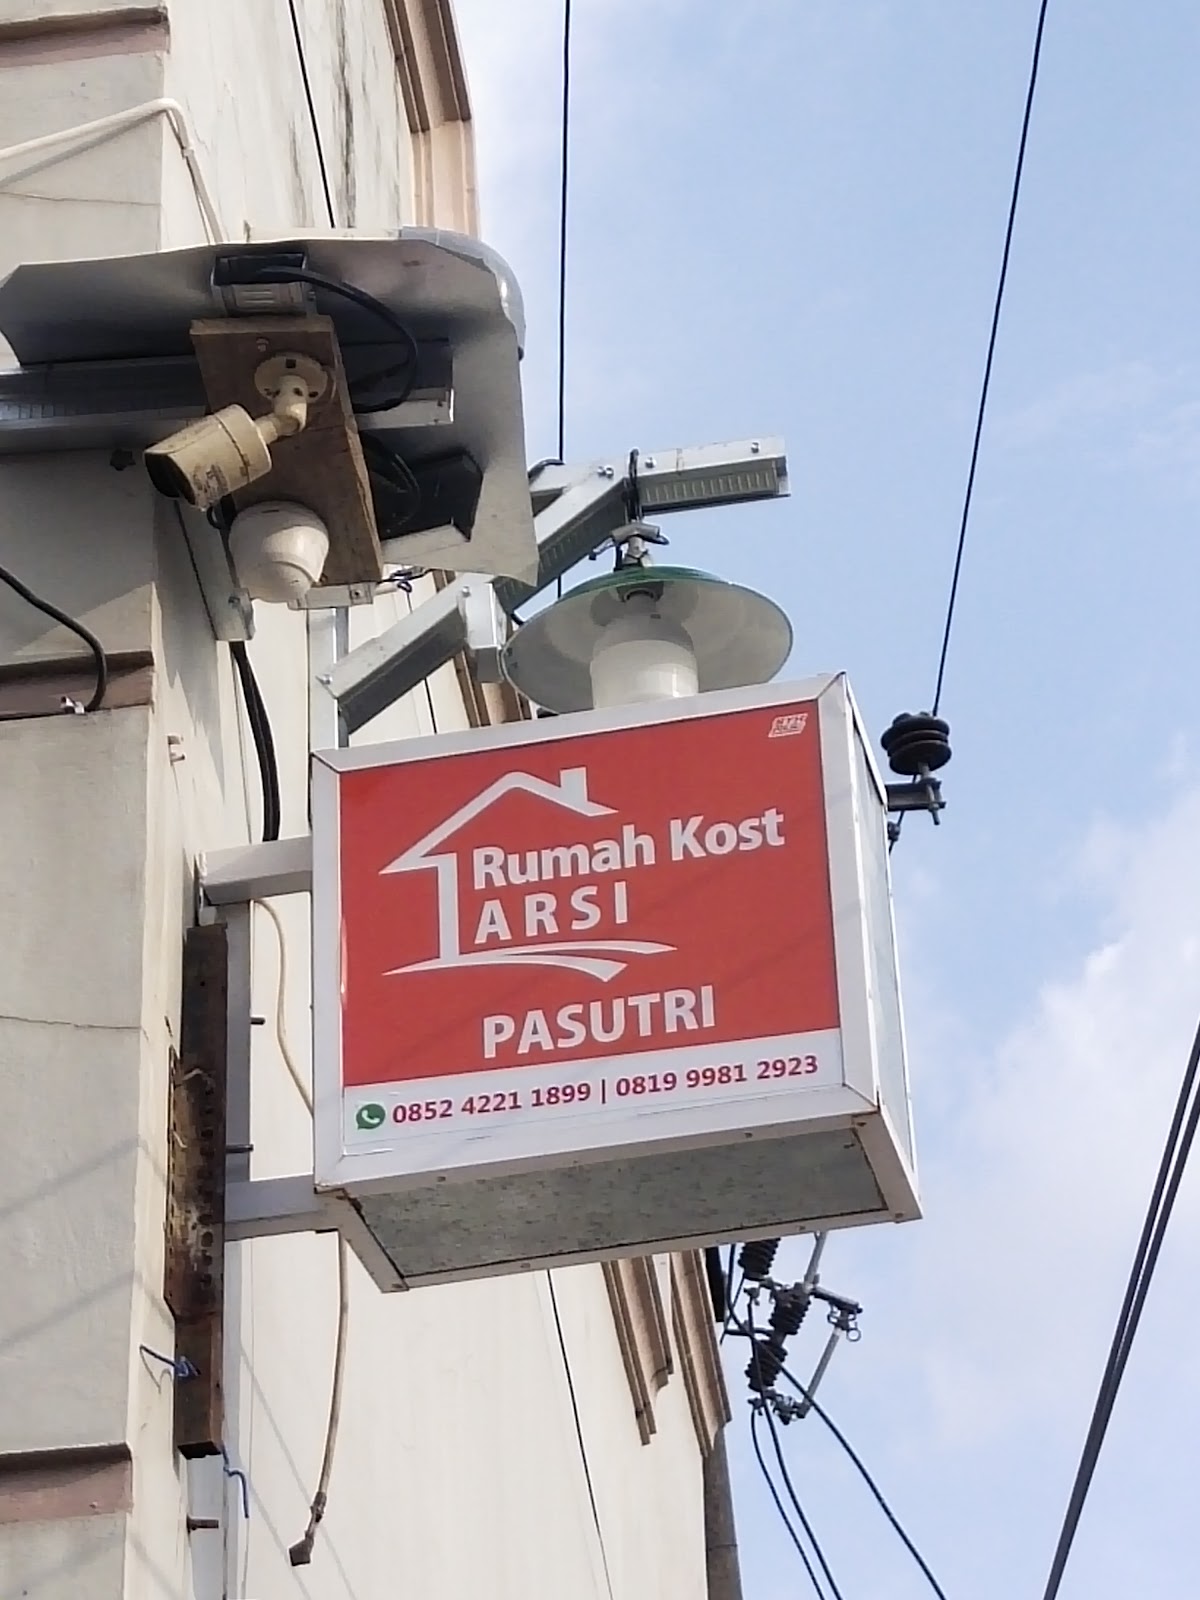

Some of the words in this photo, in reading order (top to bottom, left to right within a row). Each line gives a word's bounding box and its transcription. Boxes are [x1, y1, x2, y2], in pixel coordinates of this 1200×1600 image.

[472, 823, 656, 891] Rumah
[669, 807, 786, 862] Kost
[474, 881, 629, 945] ARSI
[482, 984, 716, 1059] PASUTRI
[392, 1099, 453, 1124] 0852
[461, 1091, 522, 1115] 4221
[531, 1082, 592, 1107] 1899
[616, 1072, 678, 1096] 0819
[686, 1064, 748, 1088] 9981
[756, 1055, 819, 1080] 2923
